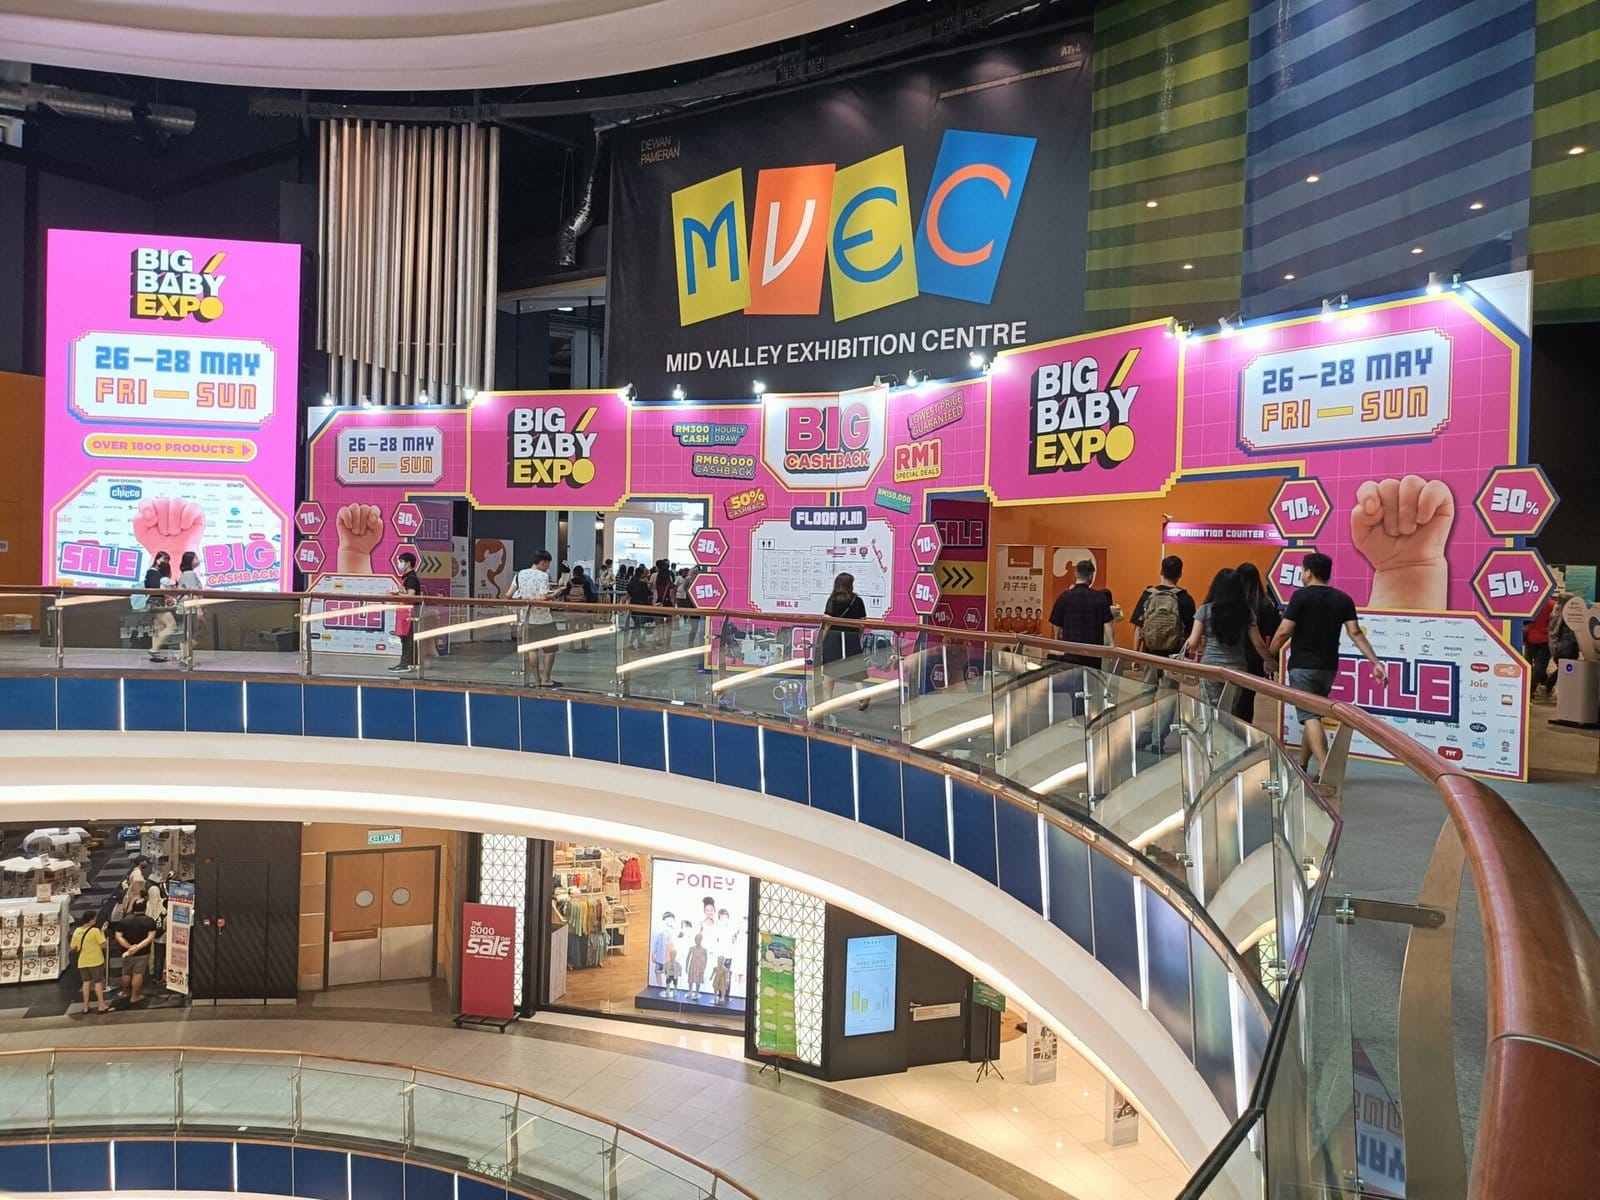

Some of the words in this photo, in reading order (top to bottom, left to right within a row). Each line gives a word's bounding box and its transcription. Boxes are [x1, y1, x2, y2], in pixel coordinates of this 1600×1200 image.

[641, 135, 672, 153] DEWAN
[640, 146, 680, 165] PAMERAN
[682, 163, 1011, 296] MVEC
[135, 248, 194, 273] BIG
[135, 272, 227, 298] BABY
[135, 294, 225, 321] EXPO
[665, 352, 702, 373] MID
[705, 344, 785, 369] VALLEY
[786, 331, 916, 364] EXHIBITION
[921, 320, 1028, 350] CENTRE
[200, 351, 261, 377] MAY
[1365, 347, 1433, 382] MAY
[1037, 355, 1099, 400] BIG
[513, 407, 567, 433] BIG
[909, 402, 940, 427] LOWEST
[911, 405, 964, 436] GUARANTEED
[1036, 385, 1140, 434] BABY
[674, 424, 710, 433] RM300
[714, 426, 746, 434] HOURLY
[681, 434, 710, 443] CASH
[714, 435, 738, 443] DRAW
[787, 403, 871, 452] BIG
[92, 440, 128, 451] OVER
[131, 442, 162, 453] 1800
[165, 443, 235, 455] PRODUCTS
[402, 436, 435, 451] MAY
[513, 433, 598, 458] BABY
[1035, 424, 1136, 469] EXPO
[694, 454, 754, 468] RM60,000
[784, 450, 870, 472] CASHBACK
[896, 442, 940, 471] RM1
[513, 458, 596, 484] EXPO
[694, 464, 754, 478] CASHBACK
[895, 469, 920, 480] SPECIAL
[920, 467, 940, 477] DEALS
[111, 486, 141, 498] chicco
[730, 488, 765, 510] 50%
[1490, 486, 1540, 515] 30%
[300, 511, 321, 525] 70%
[397, 511, 418, 528] 30%
[728, 502, 767, 518] CASHBACK
[796, 512, 838, 526] FLOOR
[839, 511, 863, 525] PLAN
[1281, 496, 1320, 521] 70%
[916, 536, 937, 553] 70%
[1225, 528, 1264, 539] COUNTER
[204, 540, 278, 576] BIG
[299, 549, 320, 564] 50%
[697, 538, 721, 556] 30%
[60, 542, 139, 580] SALE
[207, 567, 280, 588] CASHBACK
[1279, 562, 1304, 588] 50
[1487, 570, 1540, 599] 50%
[695, 584, 721, 599] 50%
[915, 583, 935, 603] 50%
[1002, 582, 1037, 592] 月子平台
[1327, 656, 1452, 716] SALE
[675, 872, 735, 891] PONEY
[470, 925, 495, 936] SOGO
[465, 936, 511, 957] sale
